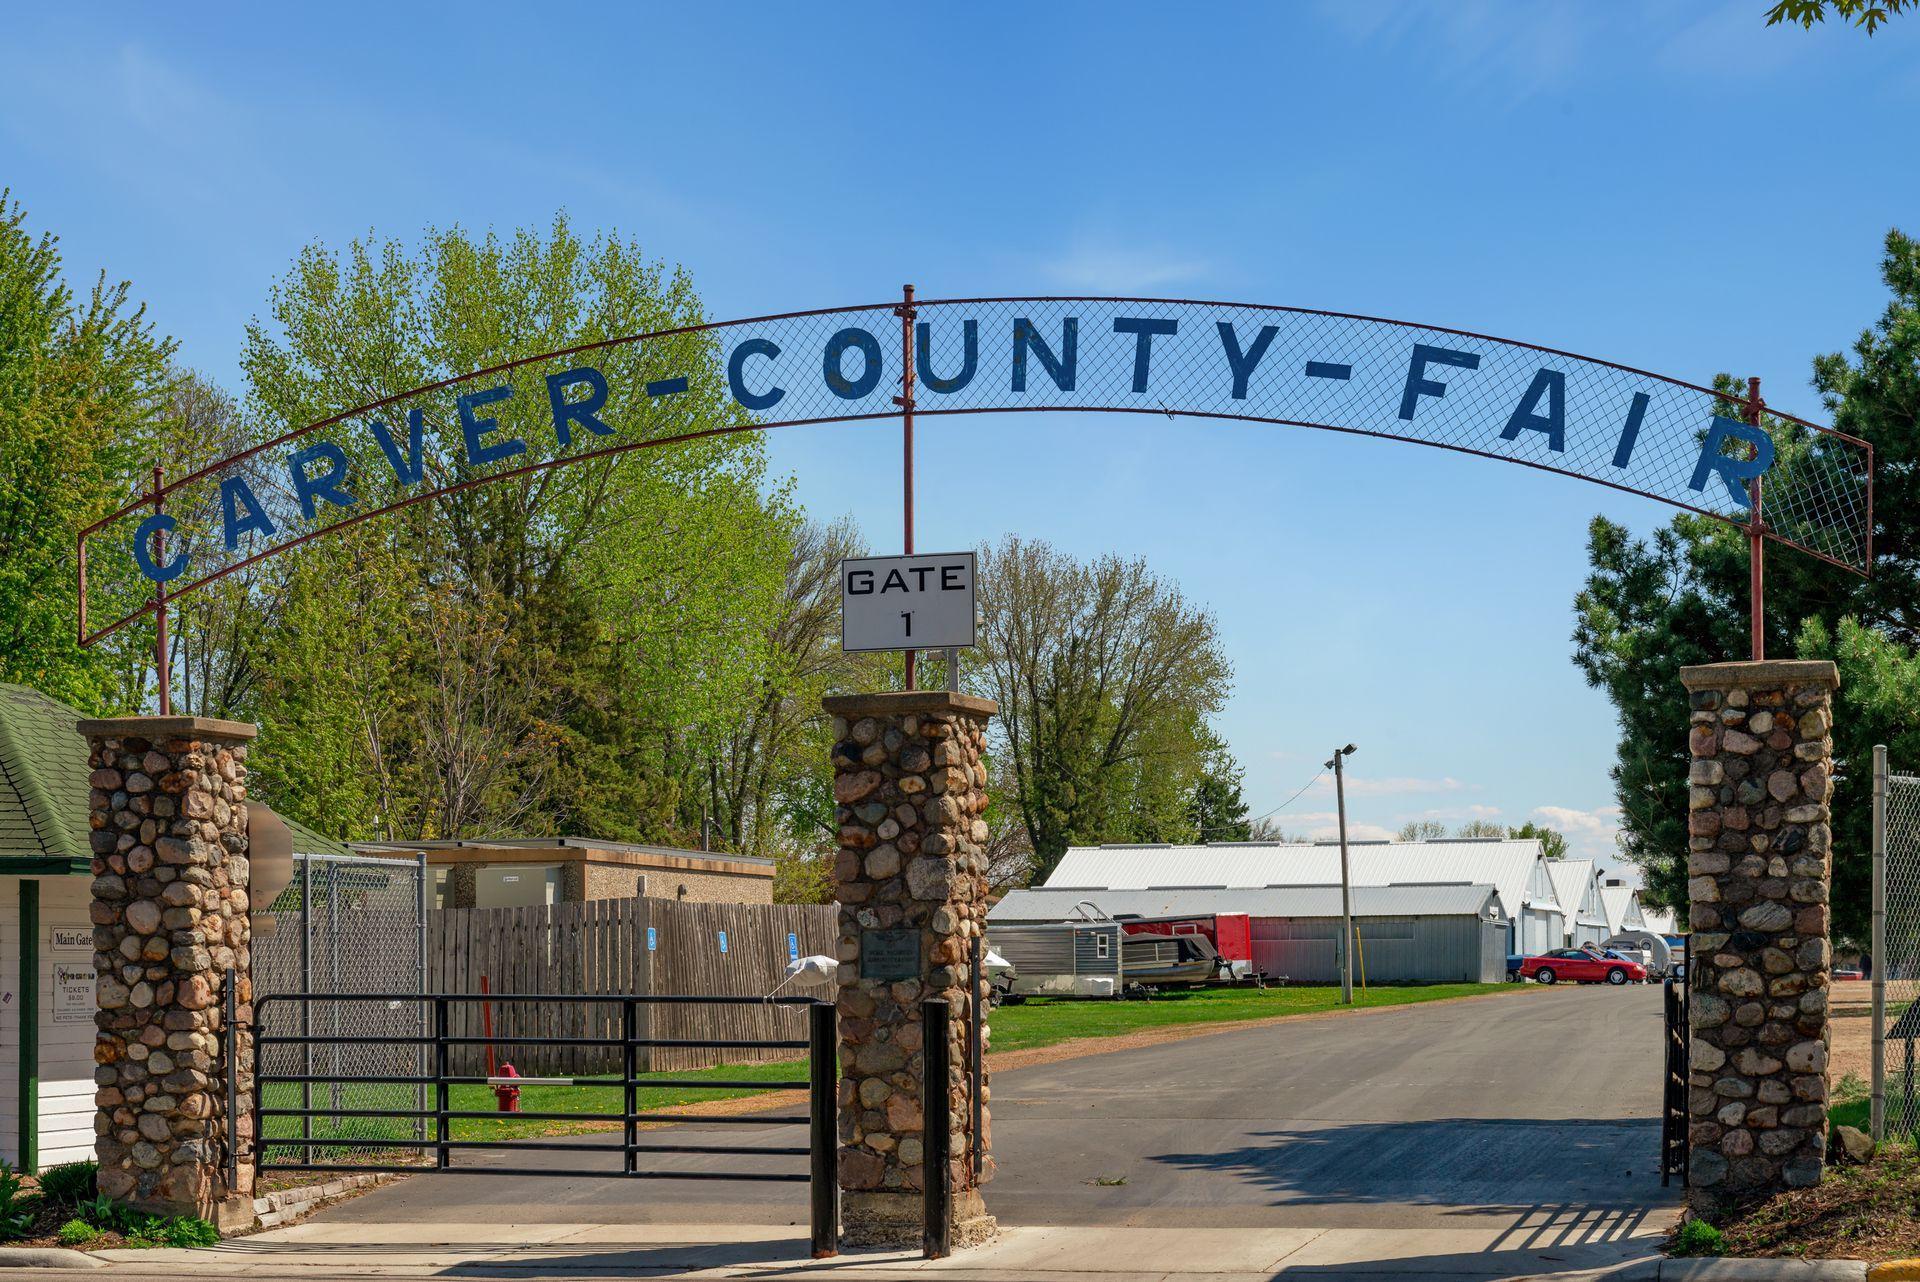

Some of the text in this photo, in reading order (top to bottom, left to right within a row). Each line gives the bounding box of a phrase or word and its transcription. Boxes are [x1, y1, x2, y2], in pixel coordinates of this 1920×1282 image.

[134, 367, 615, 583] CARVER
[728, 317, 1278, 410] COUNTY
[1398, 343, 1775, 512] FAIR
[847, 565, 966, 595] GATE
[900, 610, 913, 637] 1
[55, 932, 93, 945] Main Gate
[62, 986, 90, 994] TICKETS
